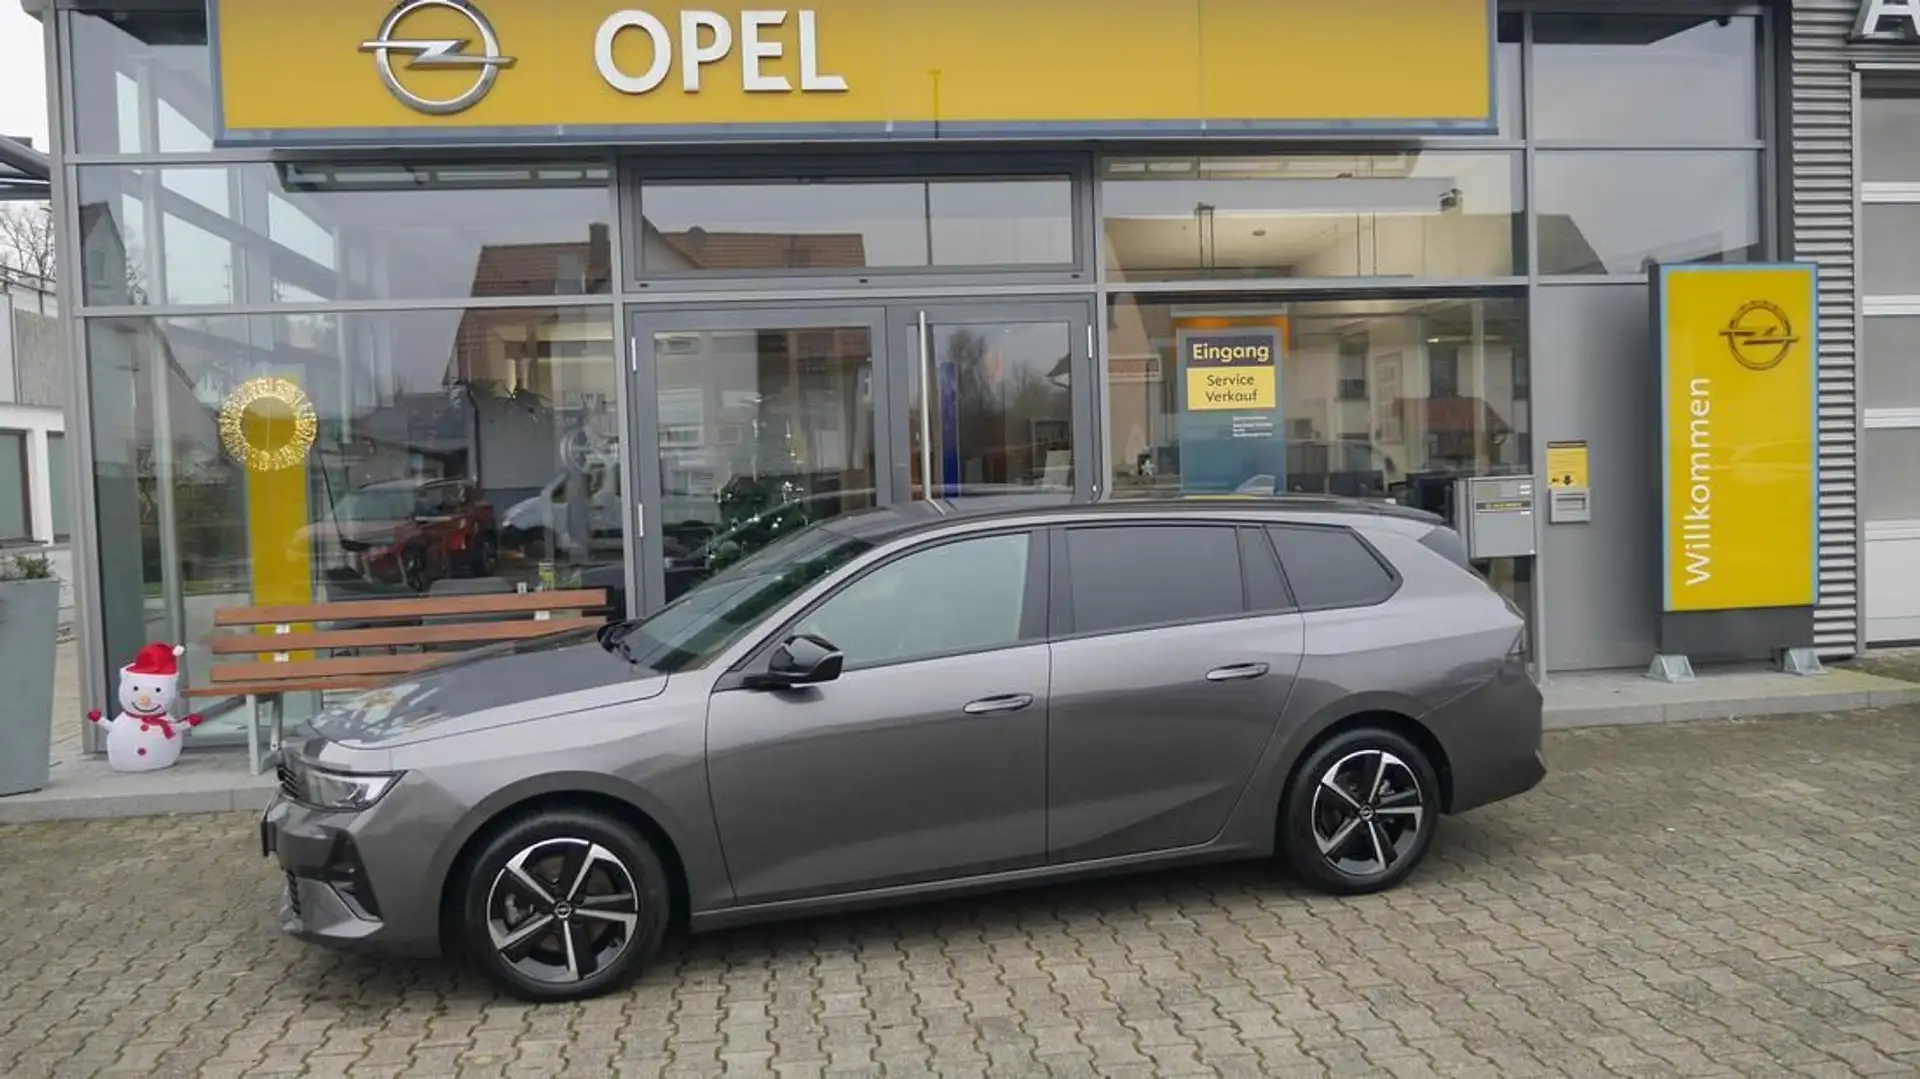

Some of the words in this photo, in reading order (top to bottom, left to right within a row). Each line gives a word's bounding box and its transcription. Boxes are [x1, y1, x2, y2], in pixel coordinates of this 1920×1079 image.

[594, 9, 849, 94] OPEL
[1192, 343, 1269, 363] Eingang
[1206, 374, 1255, 387] Service
[1205, 389, 1258, 402] Verkauf
[1684, 377, 1712, 586] Willkommen
